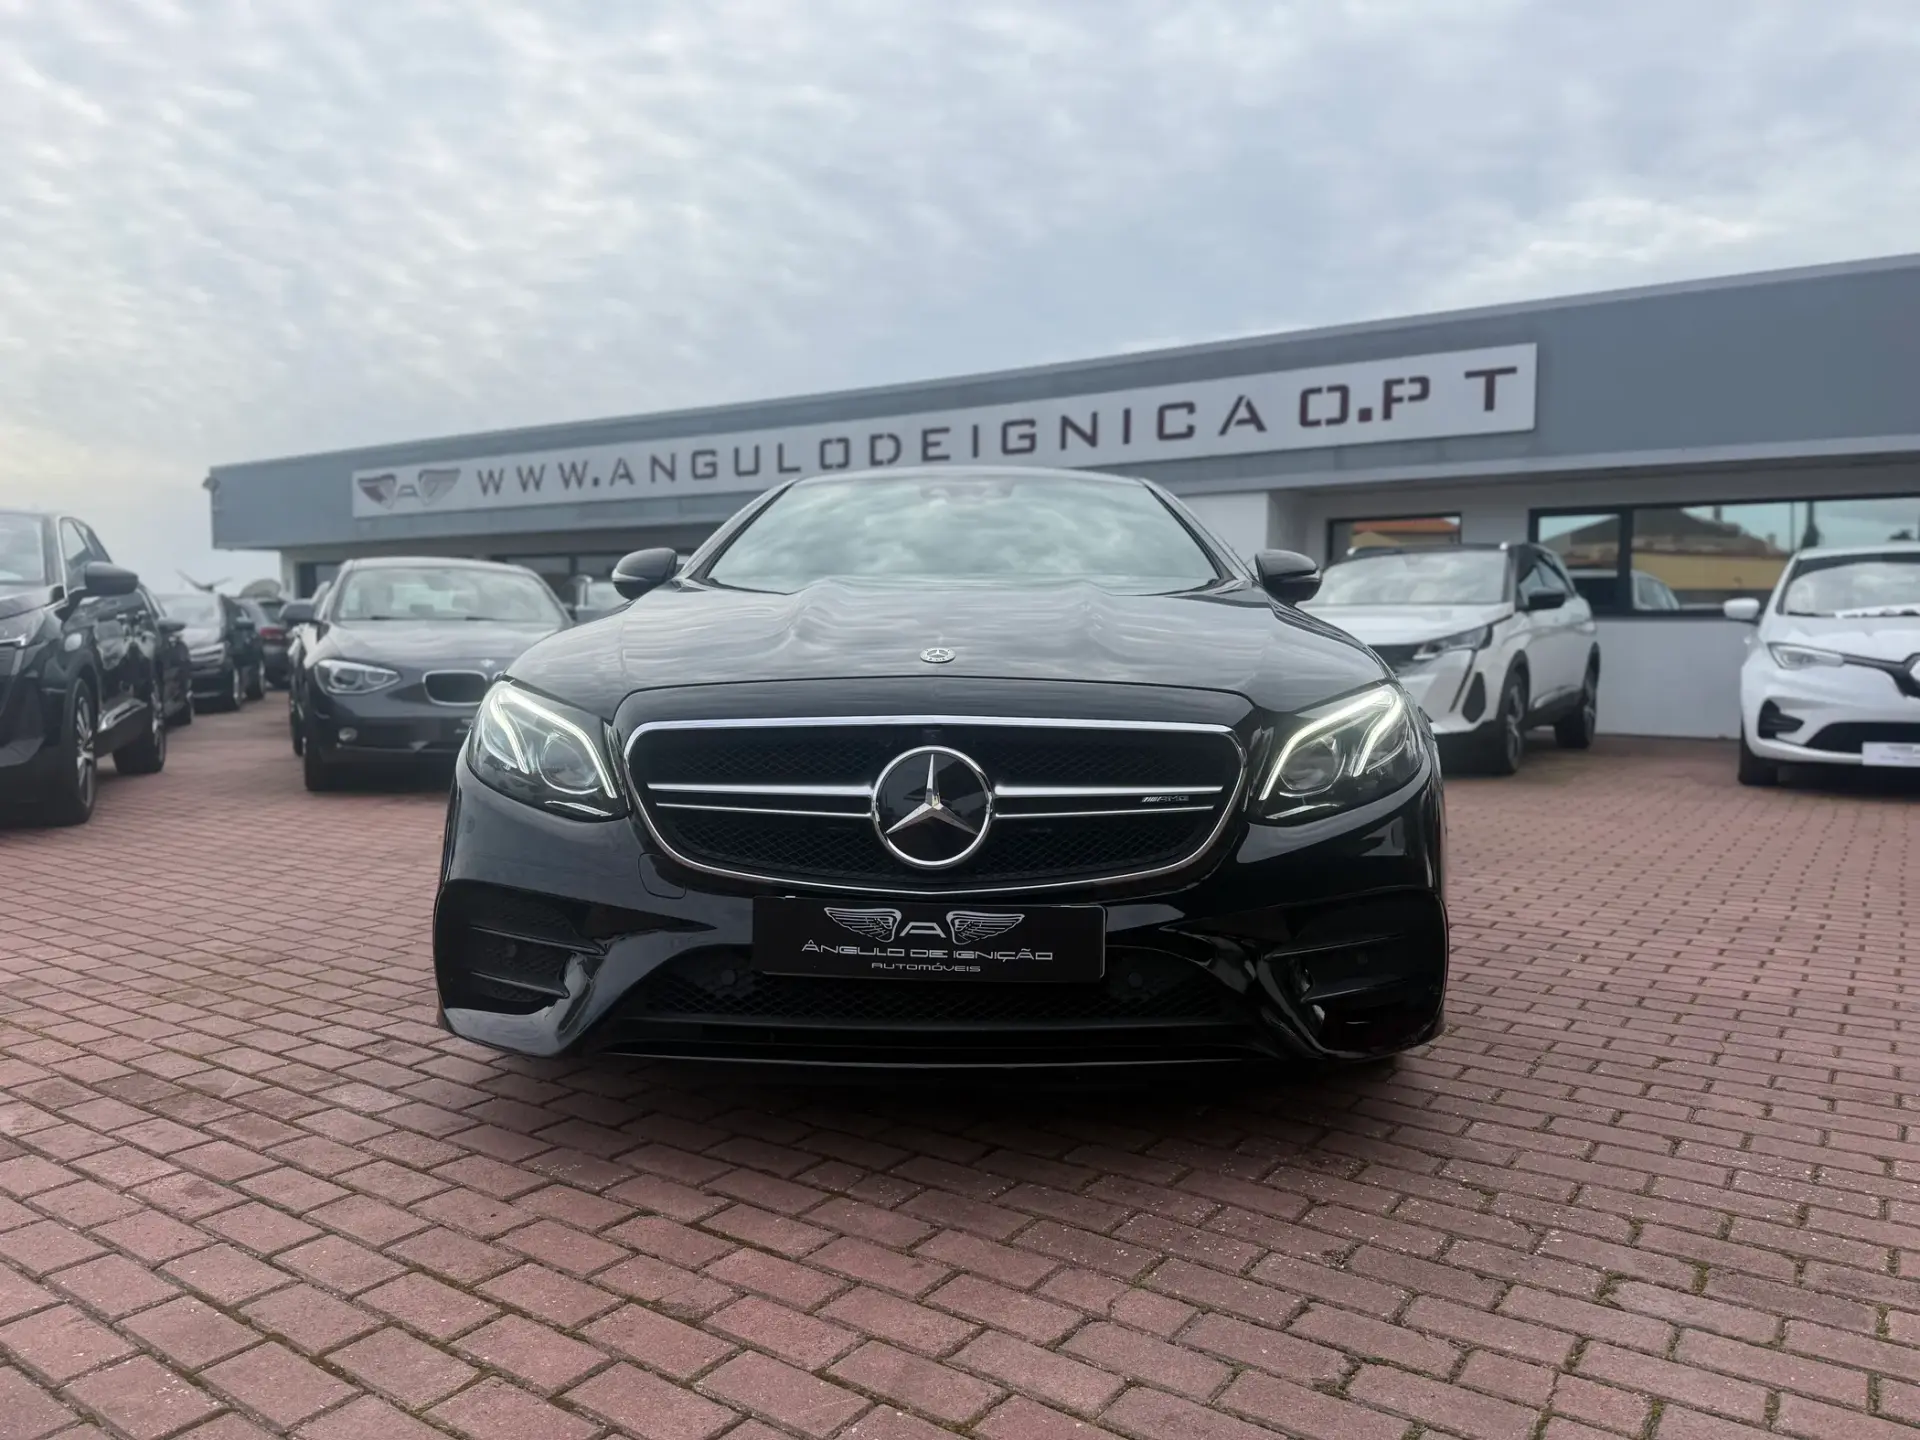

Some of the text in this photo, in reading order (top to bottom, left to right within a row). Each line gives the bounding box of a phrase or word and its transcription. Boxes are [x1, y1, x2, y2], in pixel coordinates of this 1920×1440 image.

[899, 921, 947, 938] A
[802, 939, 1053, 963] ÂNGULO DE IGNIÇÃO
[871, 962, 981, 973] AUTOMÓVEIS
